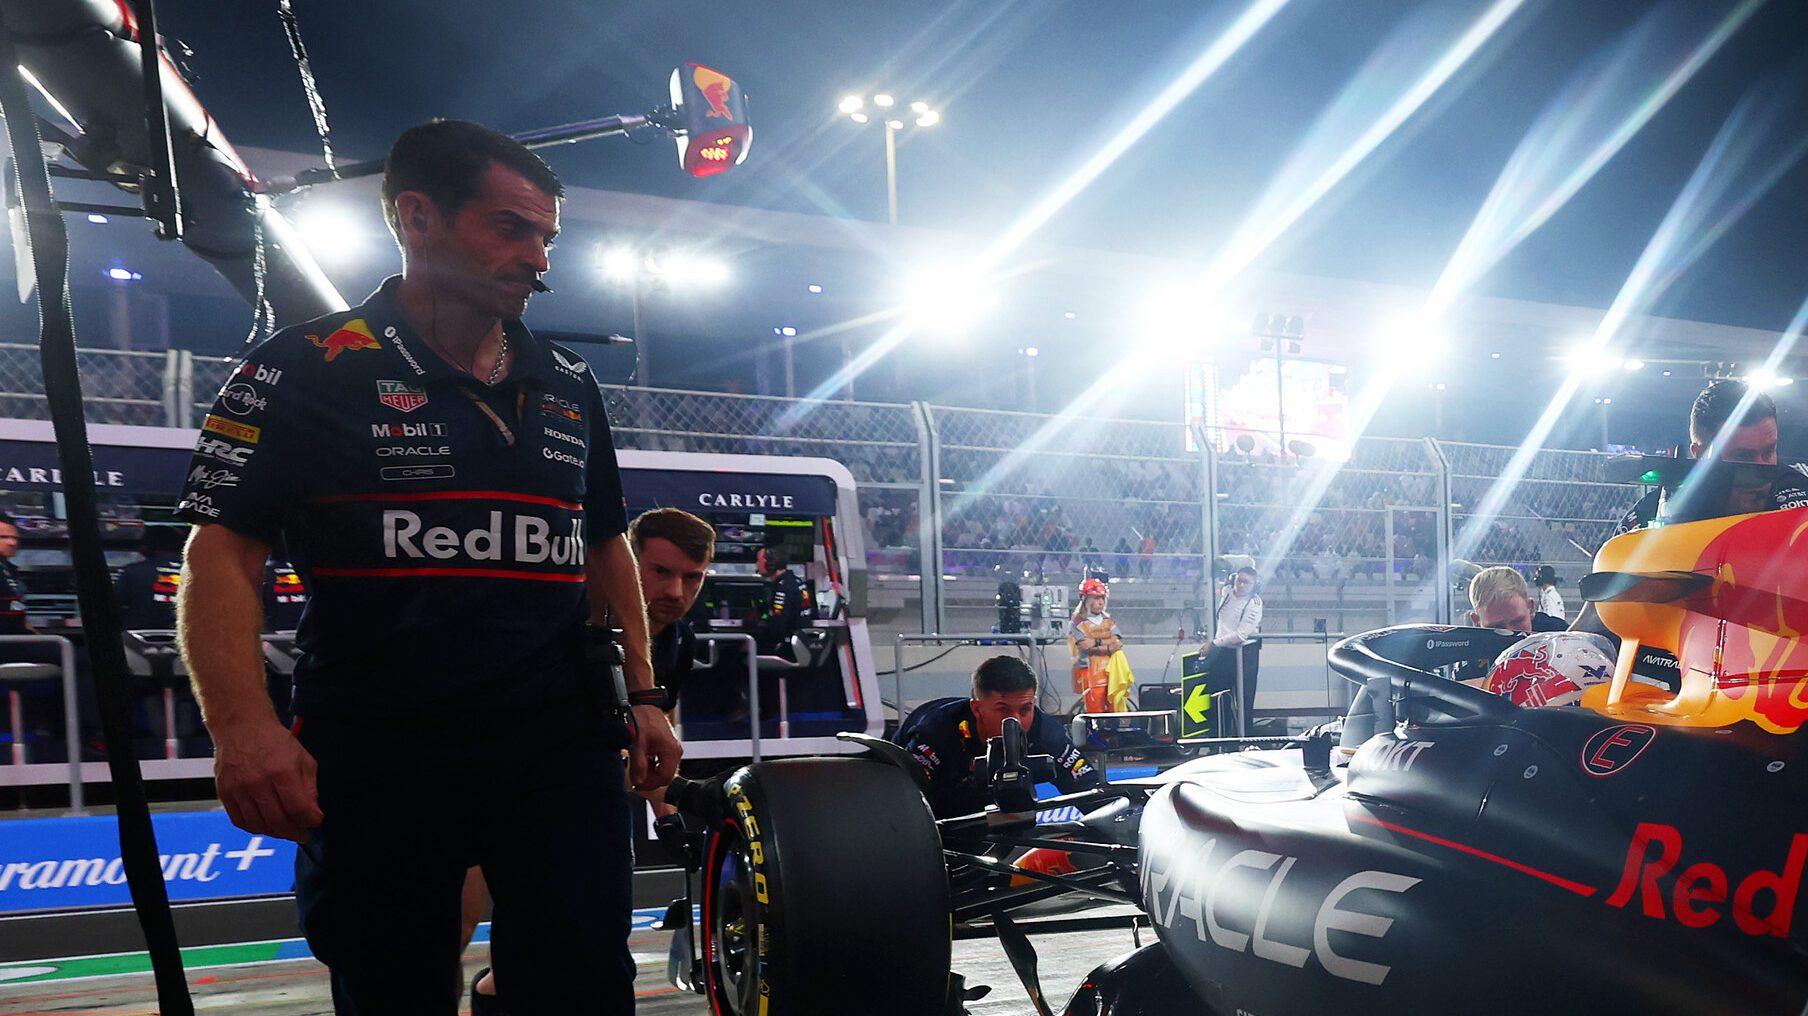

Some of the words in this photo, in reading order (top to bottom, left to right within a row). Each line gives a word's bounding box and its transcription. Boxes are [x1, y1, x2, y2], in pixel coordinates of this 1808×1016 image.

[242, 363, 283, 386] obil
[382, 394, 425, 410] HEUER
[372, 424, 428, 438] Mobil
[435, 424, 444, 436] 1
[543, 427, 586, 449] HONDA
[375, 446, 452, 457] ORACLE
[698, 493, 795, 509] CARLYLE
[382, 508, 503, 561] Red
[514, 514, 585, 566] Bull
[1435, 639, 1470, 648] 1Password
[1376, 740, 1436, 772] OKT
[0, 836, 275, 892] ramont+
[1137, 838, 1424, 987] RACLE
